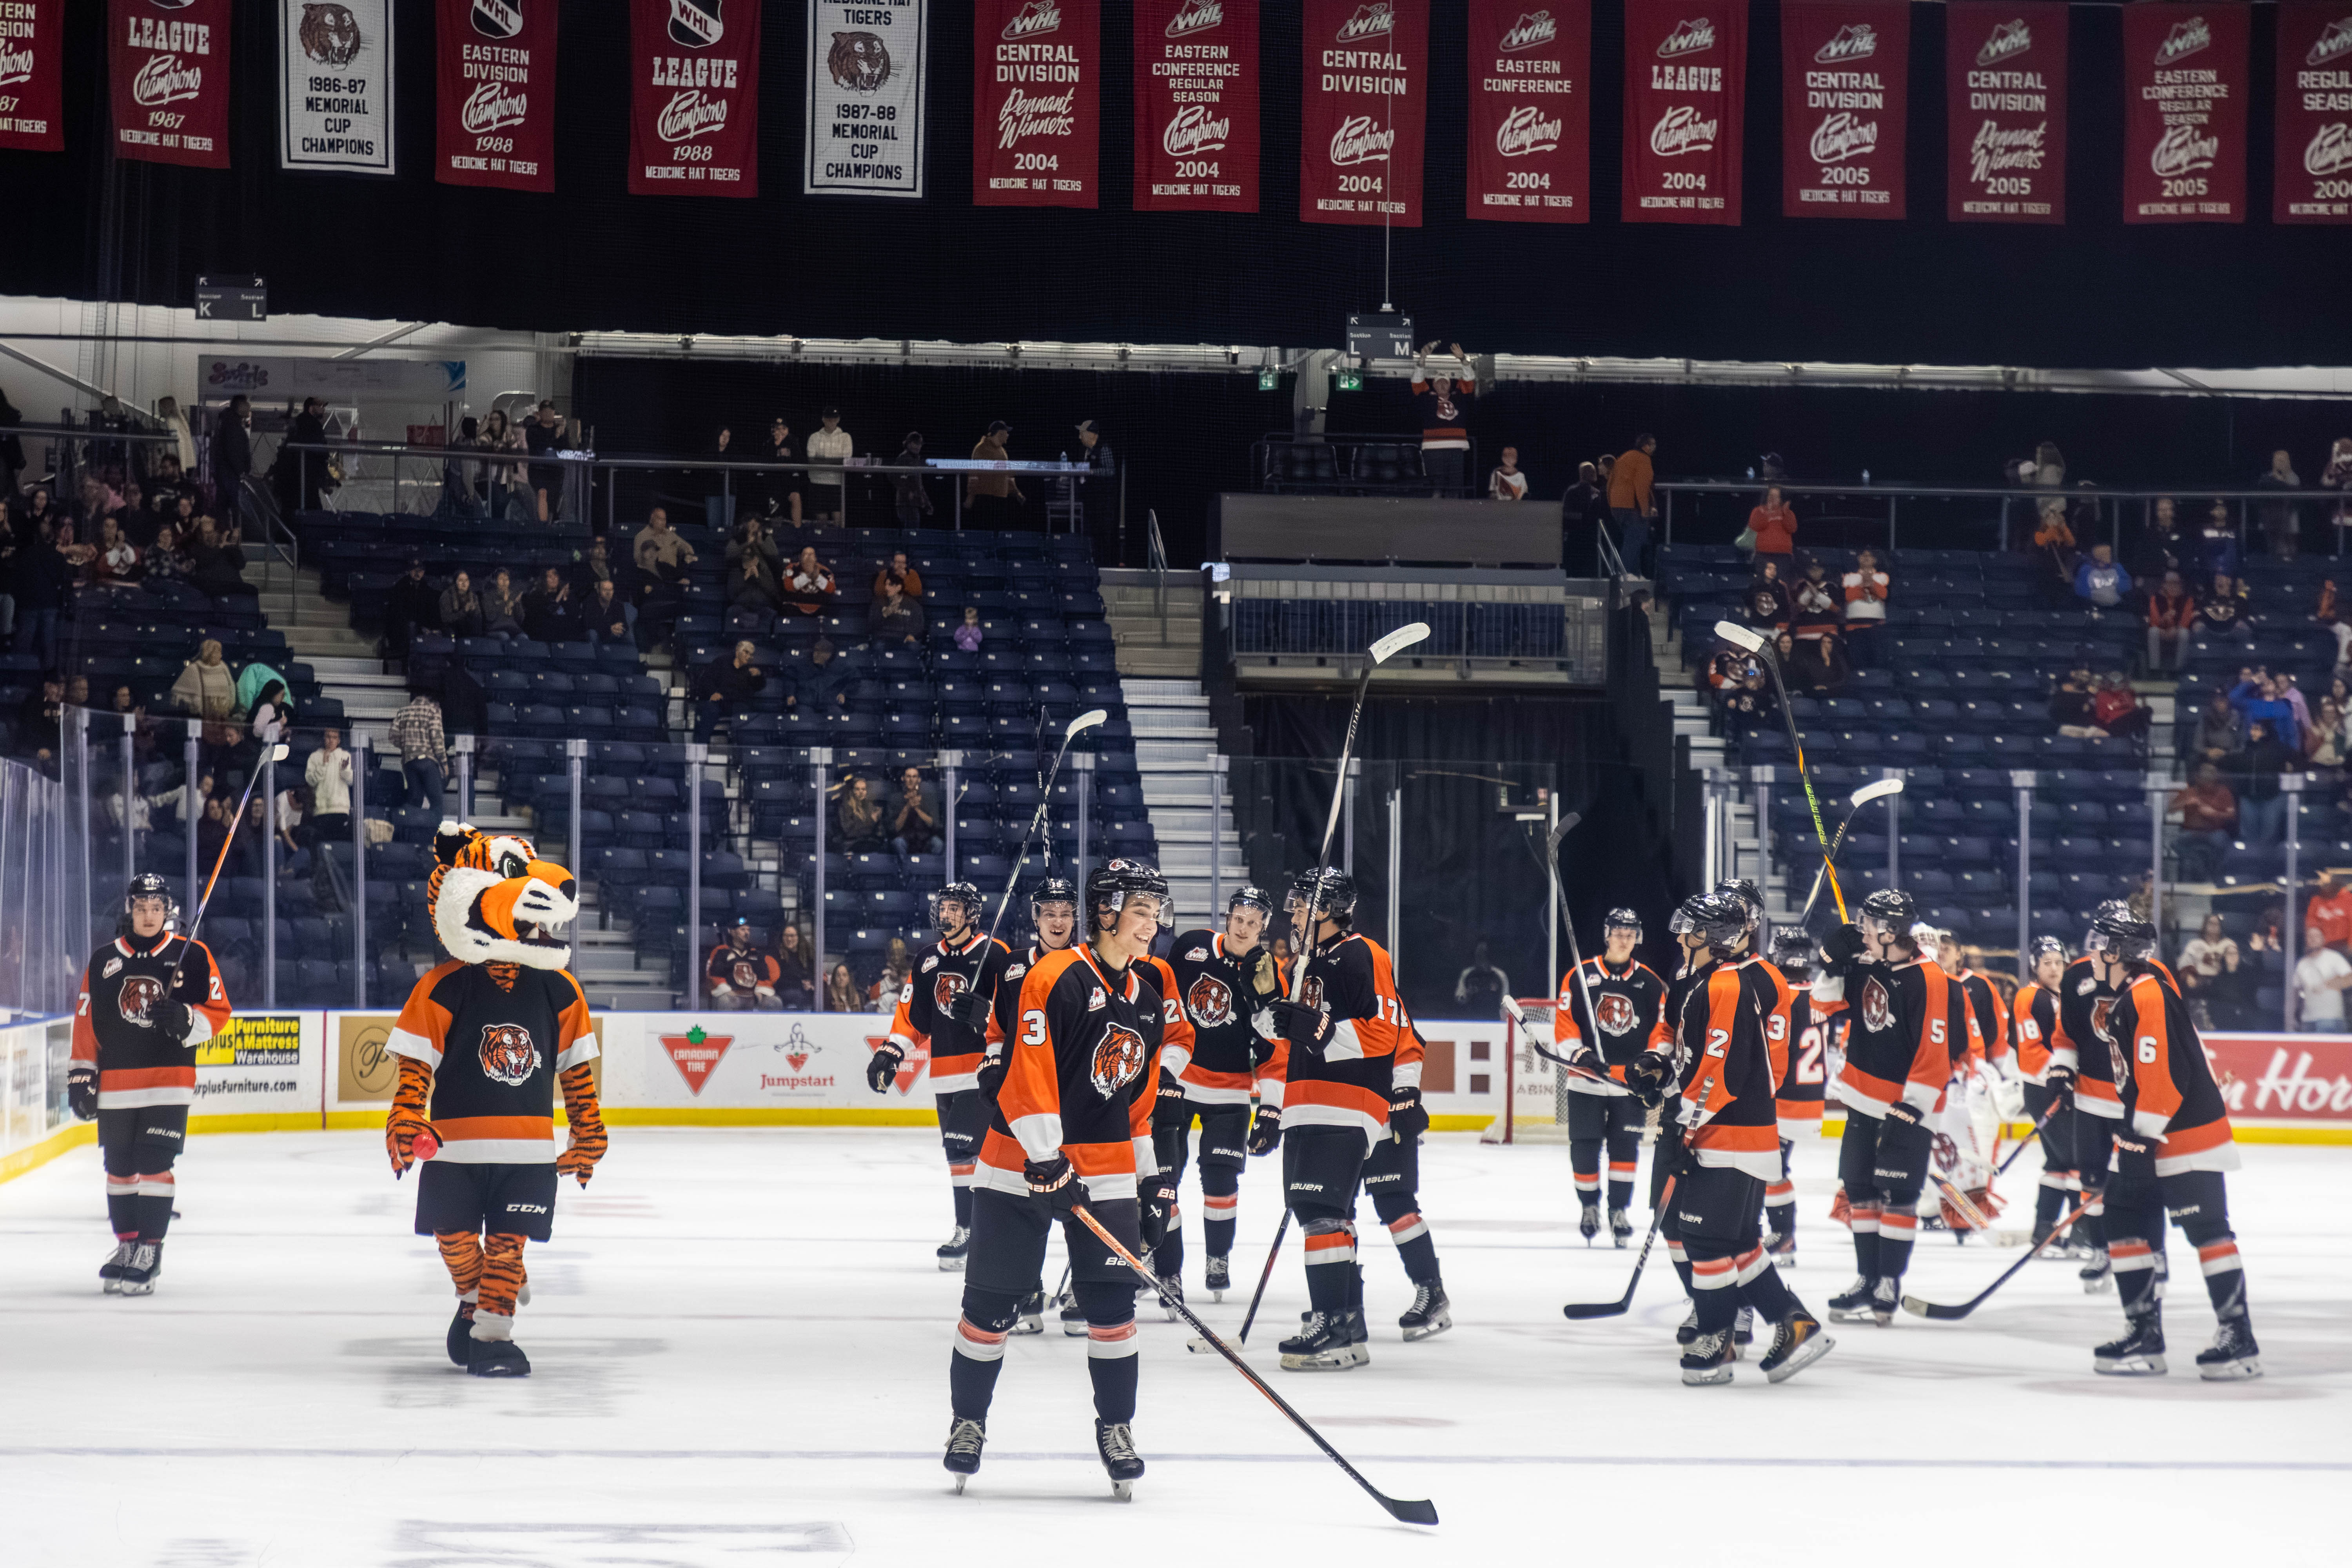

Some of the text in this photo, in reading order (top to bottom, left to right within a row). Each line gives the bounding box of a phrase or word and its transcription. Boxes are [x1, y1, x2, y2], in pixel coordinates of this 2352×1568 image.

[482, 0, 512, 29] WHL
[678, 7, 713, 36] WHL
[844, 9, 892, 25] TIGERS
[1015, 8, 1061, 34] WHL
[1176, 3, 1223, 30] WHL
[1348, 11, 1395, 36] WHL
[128, 17, 210, 55] LEAGUE
[1510, 19, 1557, 46] WHL
[1669, 26, 1715, 53] WHL
[463, 44, 529, 65] EASTERN
[996, 44, 1079, 62] CENTRAL
[1165, 45, 1229, 58] EASTERN
[1152, 63, 1240, 76] CONFERENCE
[1323, 51, 1406, 71] CENTRAL
[1496, 59, 1561, 74] EASTERN
[133, 54, 201, 106] Champions
[464, 63, 528, 83] DIVISION
[652, 56, 737, 89] LEAGUE
[996, 65, 1080, 83] DIVISION
[1651, 65, 1722, 92] LEAGUE
[1806, 71, 1885, 89] CENTRAL
[1968, 71, 2047, 89] CENTRAL
[2154, 70, 2217, 83] EASTERN
[308, 77, 366, 94] 1986-87
[1169, 79, 1223, 90] REGULAR
[1322, 74, 1406, 95] DIVISION
[1484, 79, 1572, 93] CONFERENCE
[2142, 84, 2229, 100] CONFERENCE
[306, 97, 368, 115] MEMORIAL
[999, 87, 1074, 117] Pennant
[1173, 92, 1220, 102] SEASON
[1808, 92, 1883, 110] DIVISION
[1971, 93, 2046, 112] DIVISION
[2303, 93, 2352, 111] SEAS
[462, 82, 527, 134] Champions
[657, 90, 727, 142] Champions
[836, 104, 896, 120] 1987-88
[15, 119, 47, 133] TIGERS
[148, 111, 185, 129] 1987
[324, 118, 351, 133] CUP
[832, 123, 898, 141] MEMORIAL
[999, 114, 1075, 149] Winners
[1163, 105, 1229, 156] Champions
[1497, 106, 1561, 157] Champions
[1651, 106, 1717, 157] Champions
[1810, 112, 1878, 164] Champions
[121, 129, 213, 151] MEDICINE HAT TIGERS
[301, 138, 374, 156] CHAMPIONS
[475, 136, 513, 153] 1988
[1330, 116, 1394, 166] Champions
[673, 145, 713, 162] 1988
[851, 144, 878, 159] CUP
[452, 155, 537, 176] MEDICINE HAT TIGERS
[826, 163, 902, 180] CHAMPIONS
[1015, 154, 1059, 171] 2004
[1175, 161, 1219, 178] 2004
[646, 165, 740, 181] MEDICINE HAT TIGERS
[1506, 172, 1551, 189] 2004
[1662, 172, 1706, 191] 2004
[1821, 167, 1870, 185] 2005
[990, 177, 1082, 191] MEDICINE HAT TIGERS
[1152, 184, 1240, 196] MEDICINE HAT TIGERS
[1338, 175, 1383, 193] 2004
[1986, 178, 2031, 195] 2005
[2161, 178, 2208, 197] 2005
[2314, 180, 2352, 198] 200
[1483, 194, 1573, 208] MEDICINE HAT TIGERS
[1641, 197, 1725, 209] MEDICINE HAT TIGERS
[1841, 190, 1857, 203] HAT
[1318, 199, 1406, 214] MEDICINE HAT TIGERS
[200, 302, 211, 317] K
[252, 303, 263, 318] L
[1350, 341, 1360, 355] L
[1395, 341, 1409, 356] M
[1350, 703, 1361, 740] FLYLITE
[1310, 881, 1324, 922] BAUER
[1006, 966, 1026, 978] WHL
[210, 976, 222, 1000] 2
[899, 984, 913, 1004] 8
[78, 992, 91, 1016] 7
[1558, 992, 1572, 1011] 3
[1376, 995, 1398, 1027] 17
[236, 1017, 299, 1034] Furniture
[1022, 1010, 1046, 1046] 3
[1767, 1014, 1786, 1041] 3
[1930, 1019, 1946, 1044] 5
[2017, 1019, 2040, 1043] 18
[1707, 1029, 1729, 1059] 2
[2138, 1036, 2157, 1064] 6
[236, 1049, 298, 1064] Warehouse
[673, 1049, 719, 1060] CANADIAN
[686, 1061, 706, 1073] TIRE
[899, 1062, 915, 1073] IRE
[760, 1073, 835, 1089] Jumpstart
[146, 1127, 181, 1137] BAUER
[944, 1132, 973, 1142] BAUER
[1212, 1147, 1244, 1160] BAUER
[1026, 1162, 1076, 1193] BAUER
[1366, 1174, 1401, 1185] BAUER
[1874, 1169, 1908, 1180] BAUER
[1290, 1182, 1323, 1192] BAUER
[506, 1203, 547, 1214] CCM
[1637, 1230, 1656, 1271] CCM
[1163, 1296, 1202, 1334] BAUER
